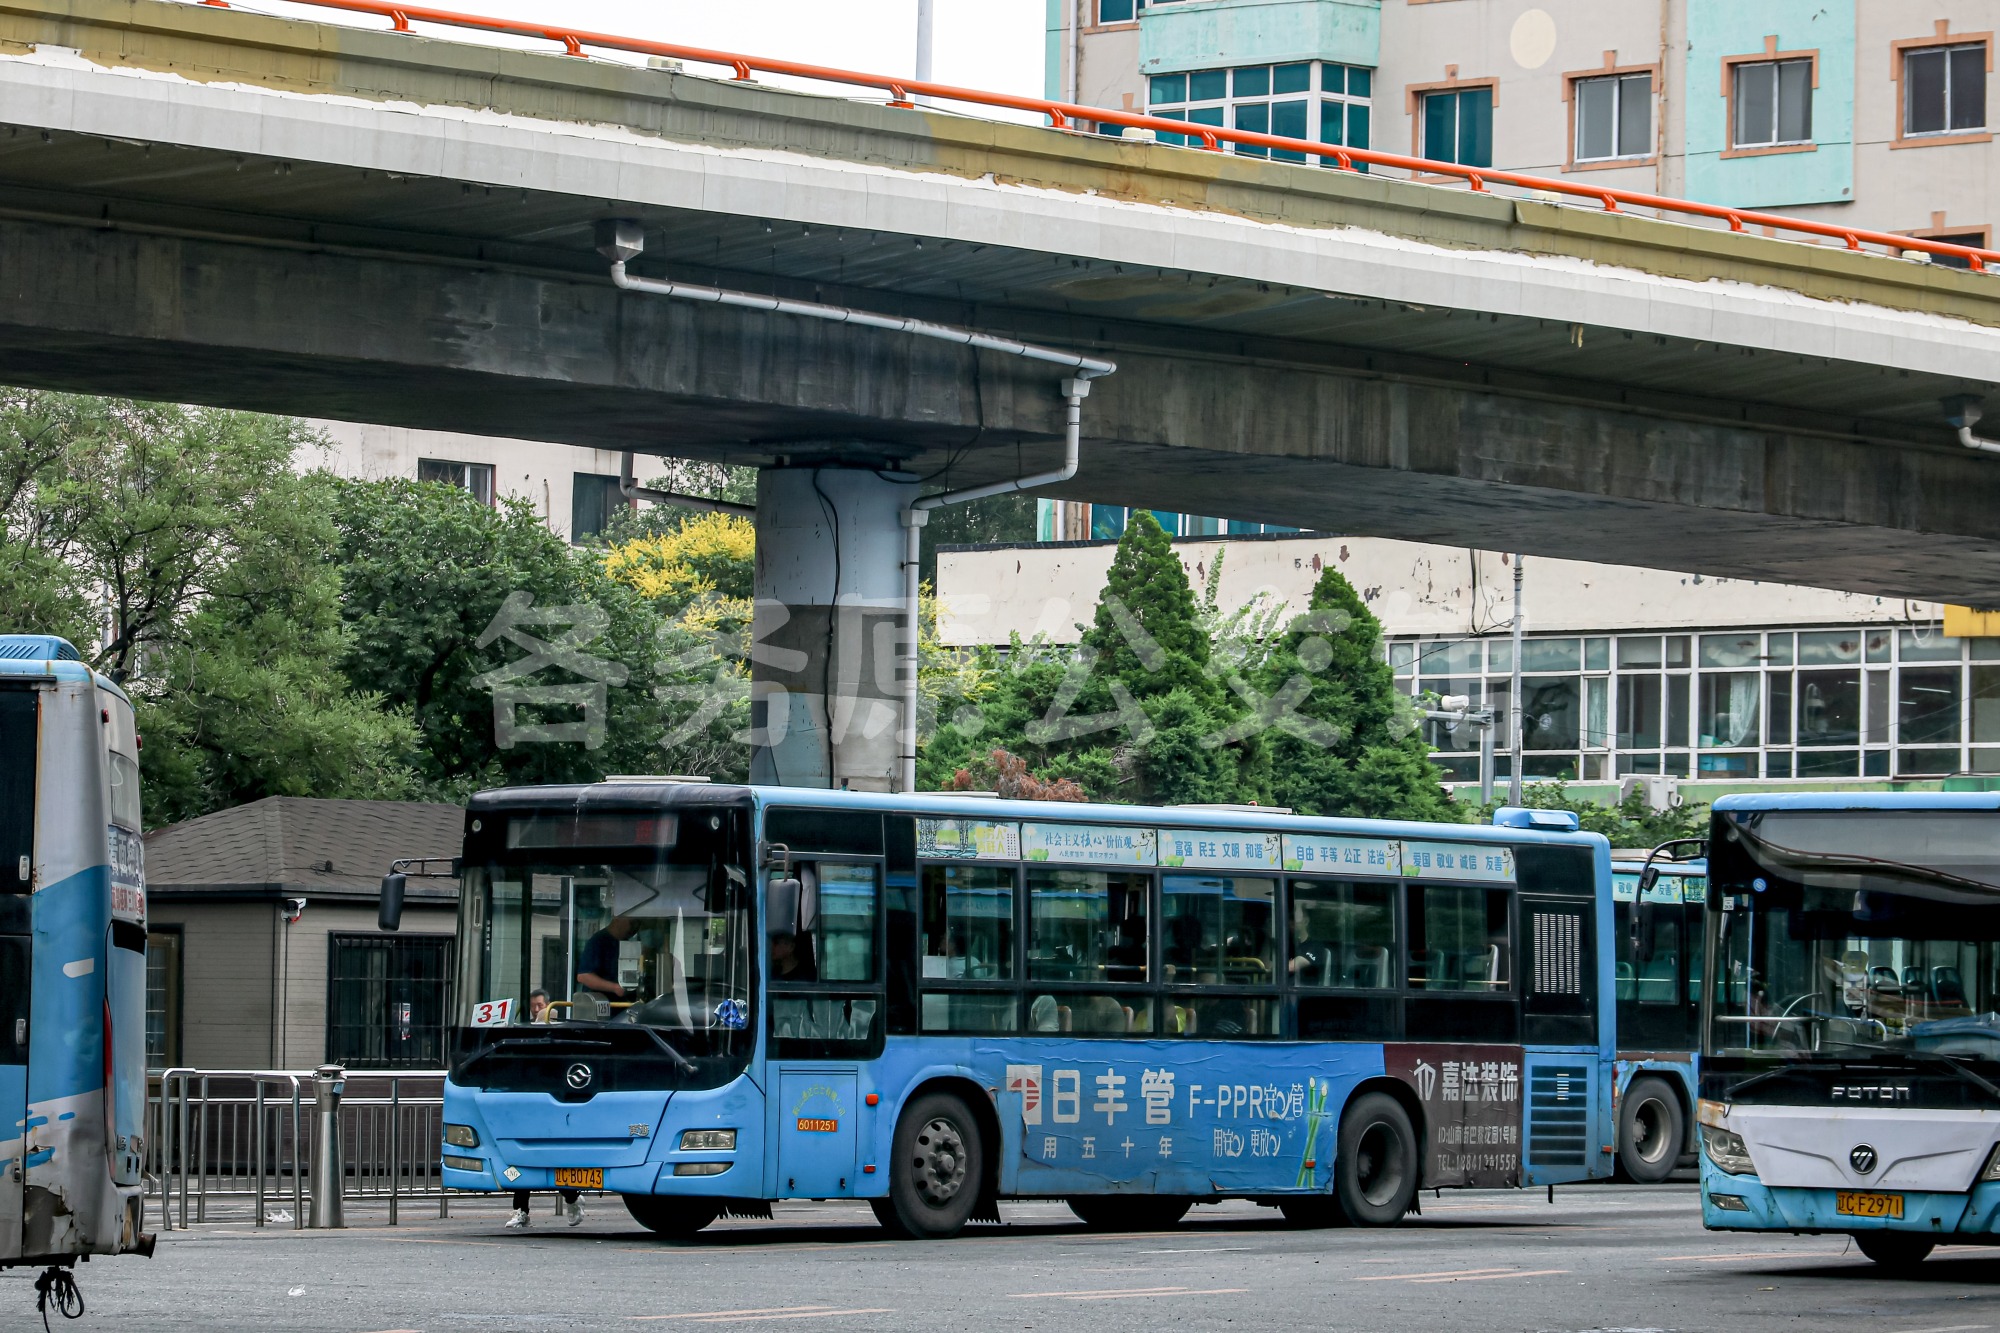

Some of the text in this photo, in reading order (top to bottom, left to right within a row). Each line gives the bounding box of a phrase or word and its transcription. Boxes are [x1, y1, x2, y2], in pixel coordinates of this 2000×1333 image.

[1045, 830, 1133, 849] 社会主义核心价值观
[1175, 840, 1263, 859] 富强 民主 文明 和谐
[1296, 845, 1385, 865] 自由 平等 公正 法治
[1413, 852, 1502, 872] 爱国 敬业 诚信 友善
[1657, 884, 1672, 896] 友善
[477, 1001, 508, 1023] 31
[1442, 1061, 1518, 1102] 嘉达装饰
[1053, 1068, 1175, 1126] 日丰管
[1831, 1086, 1910, 1100] FOTON
[798, 1119, 836, 1131] 6011251
[506, 1169, 518, 1178] LNG
